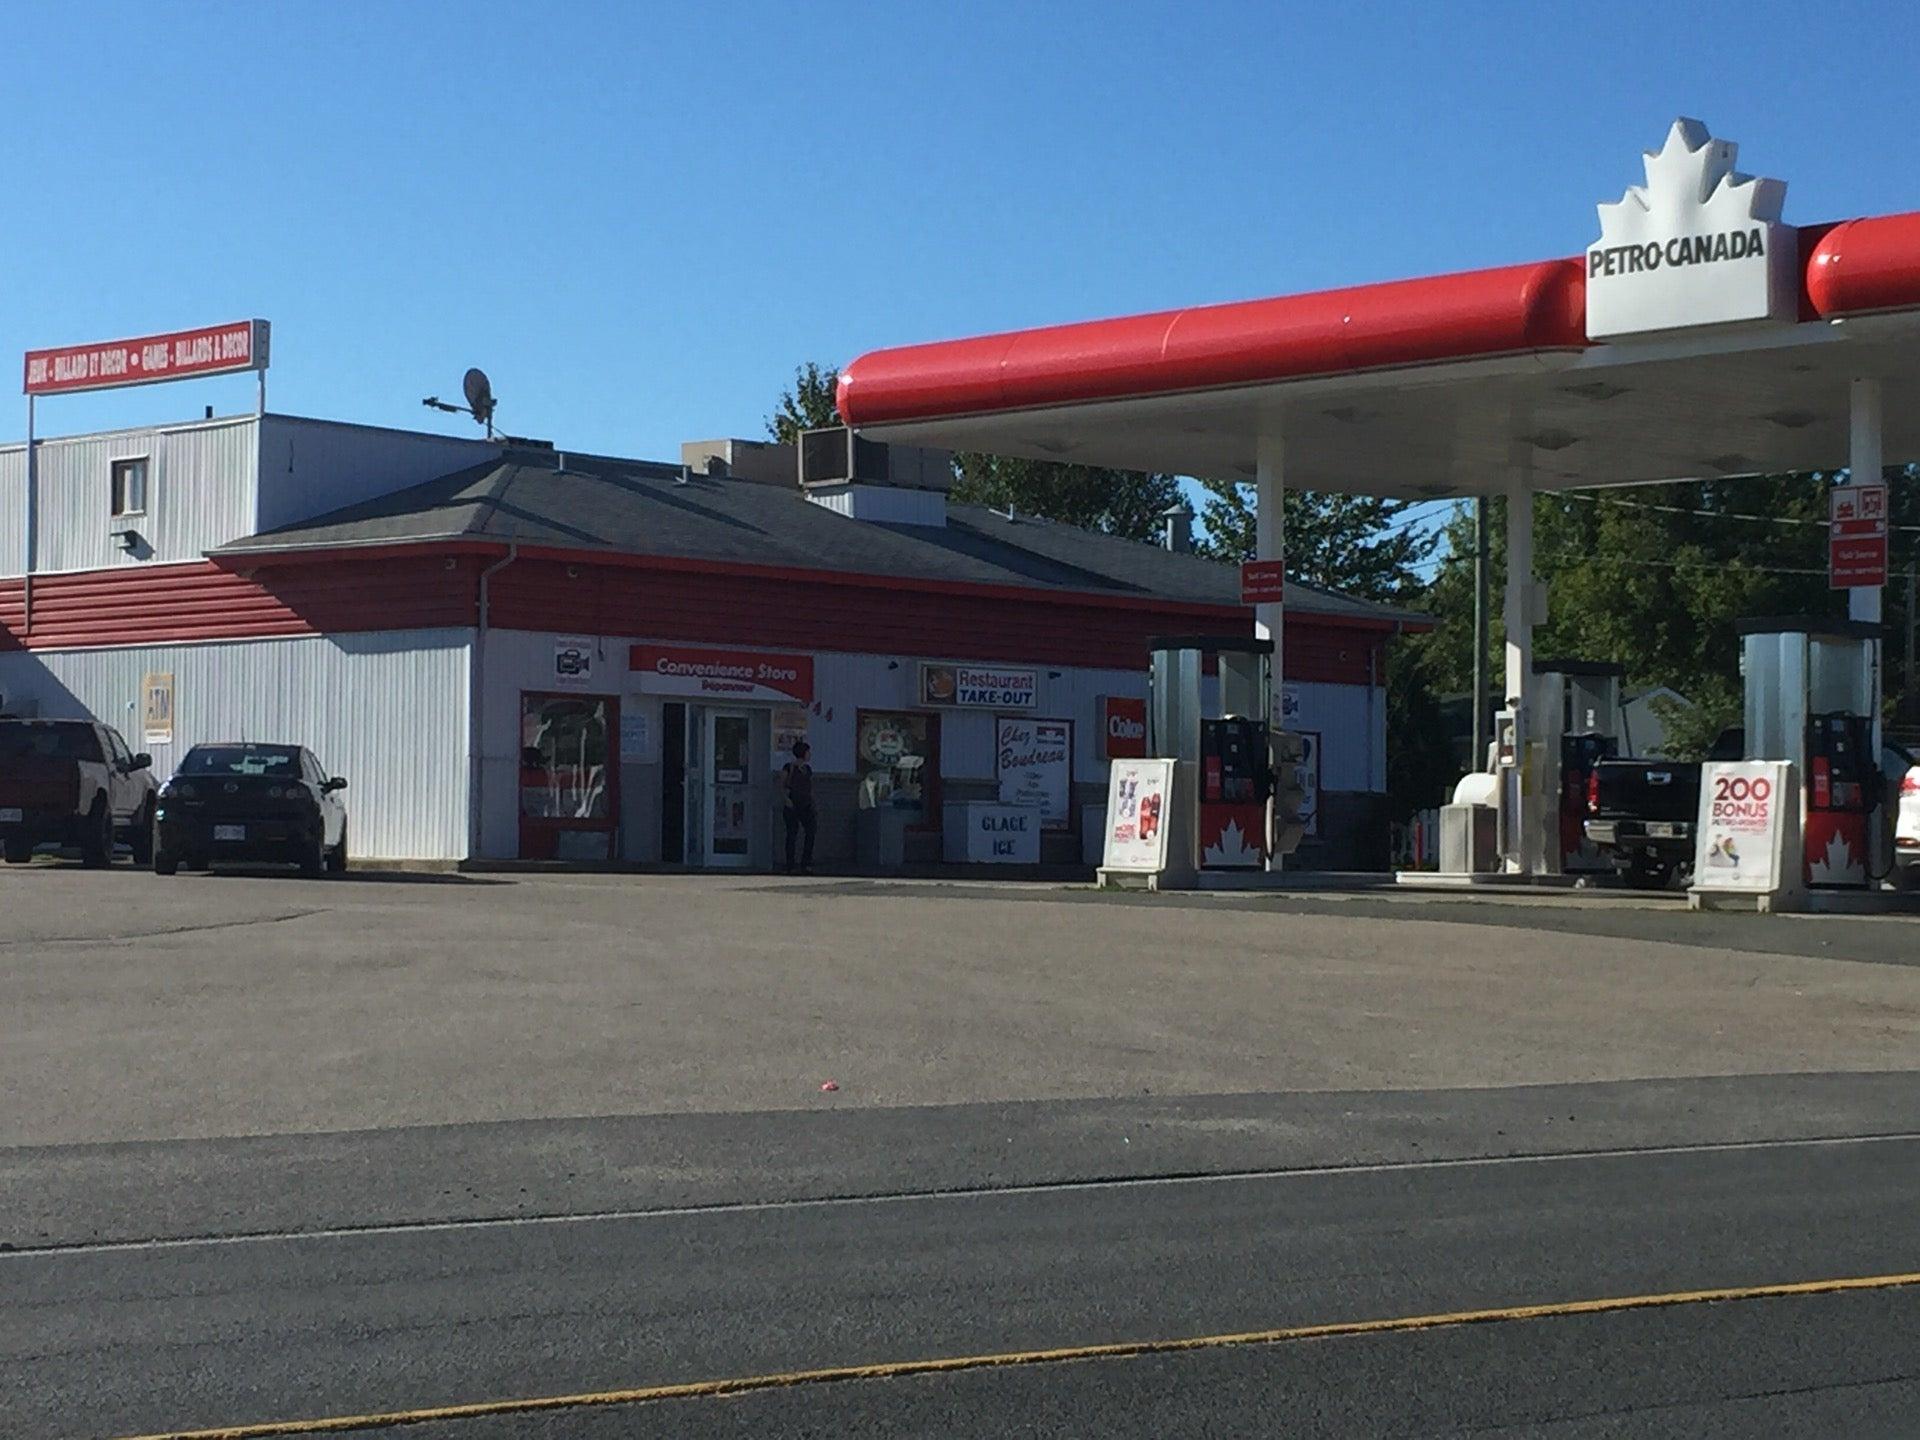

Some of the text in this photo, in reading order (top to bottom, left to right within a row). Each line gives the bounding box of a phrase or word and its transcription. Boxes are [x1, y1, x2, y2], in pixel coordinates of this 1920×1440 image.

[656, 657, 798, 682] Convenience Store
[960, 670, 1033, 689] Restaurant
[960, 689, 1033, 705] TAKE-OUT
[1001, 725, 1031, 746] Chez
[1109, 715, 1144, 739] Coke
[1714, 777, 1771, 801] 200
[1712, 803, 1768, 818] BONUS
[982, 815, 1029, 832] GLACE
[993, 839, 1017, 856] ICE
